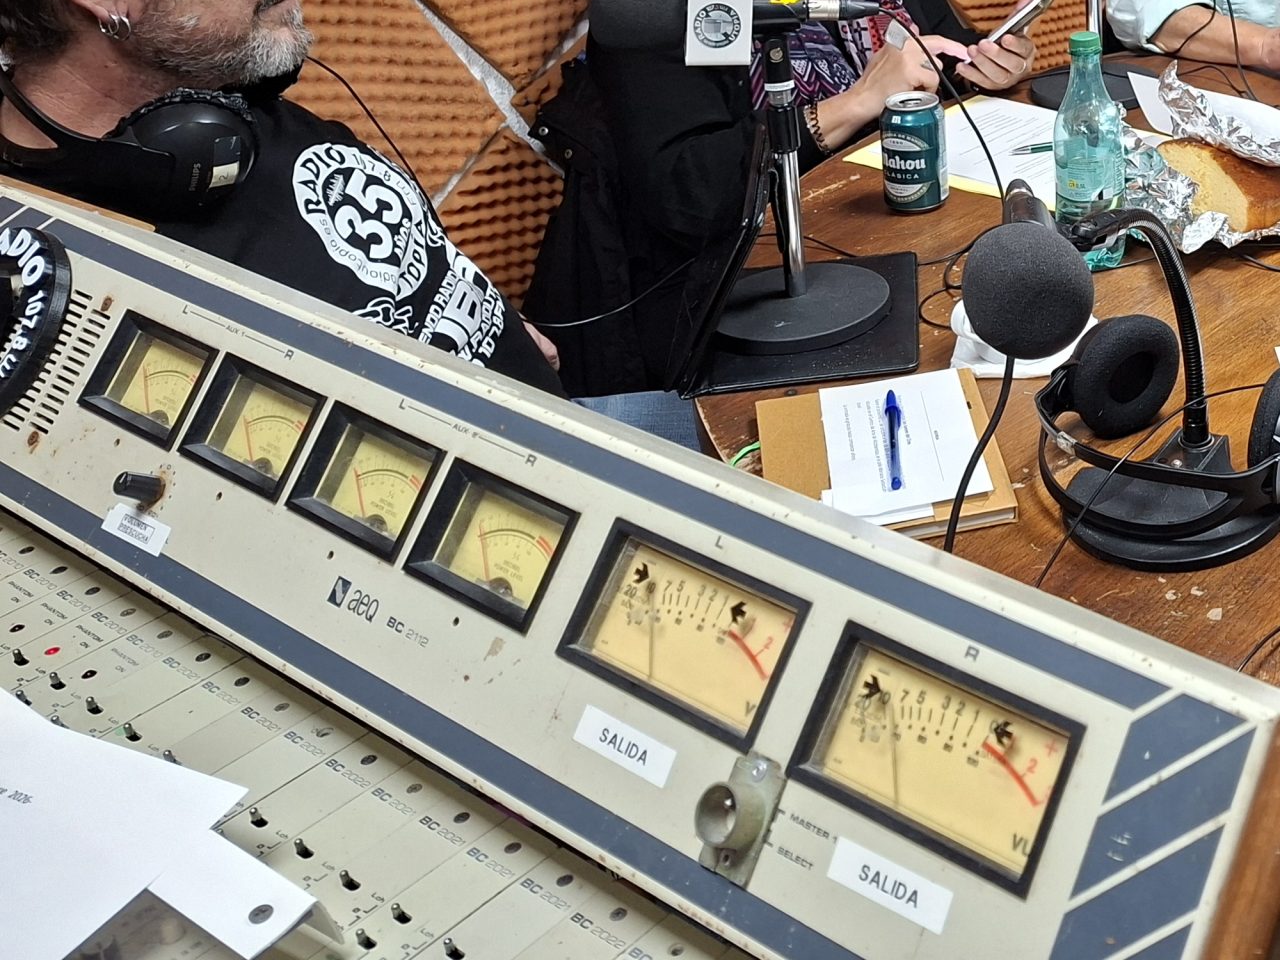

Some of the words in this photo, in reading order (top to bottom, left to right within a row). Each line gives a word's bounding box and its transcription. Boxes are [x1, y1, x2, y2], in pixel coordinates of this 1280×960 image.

[334, 169, 403, 259] 35
[0, 227, 45, 287] ADIO
[387, 616, 405, 633] BC
[405, 629, 430, 648] 2112
[964, 645, 980, 662] R
[599, 727, 649, 766] SALIDA
[789, 813, 831, 840] MASTER
[776, 845, 814, 871] SELECT
[858, 863, 920, 908] SALIDA
